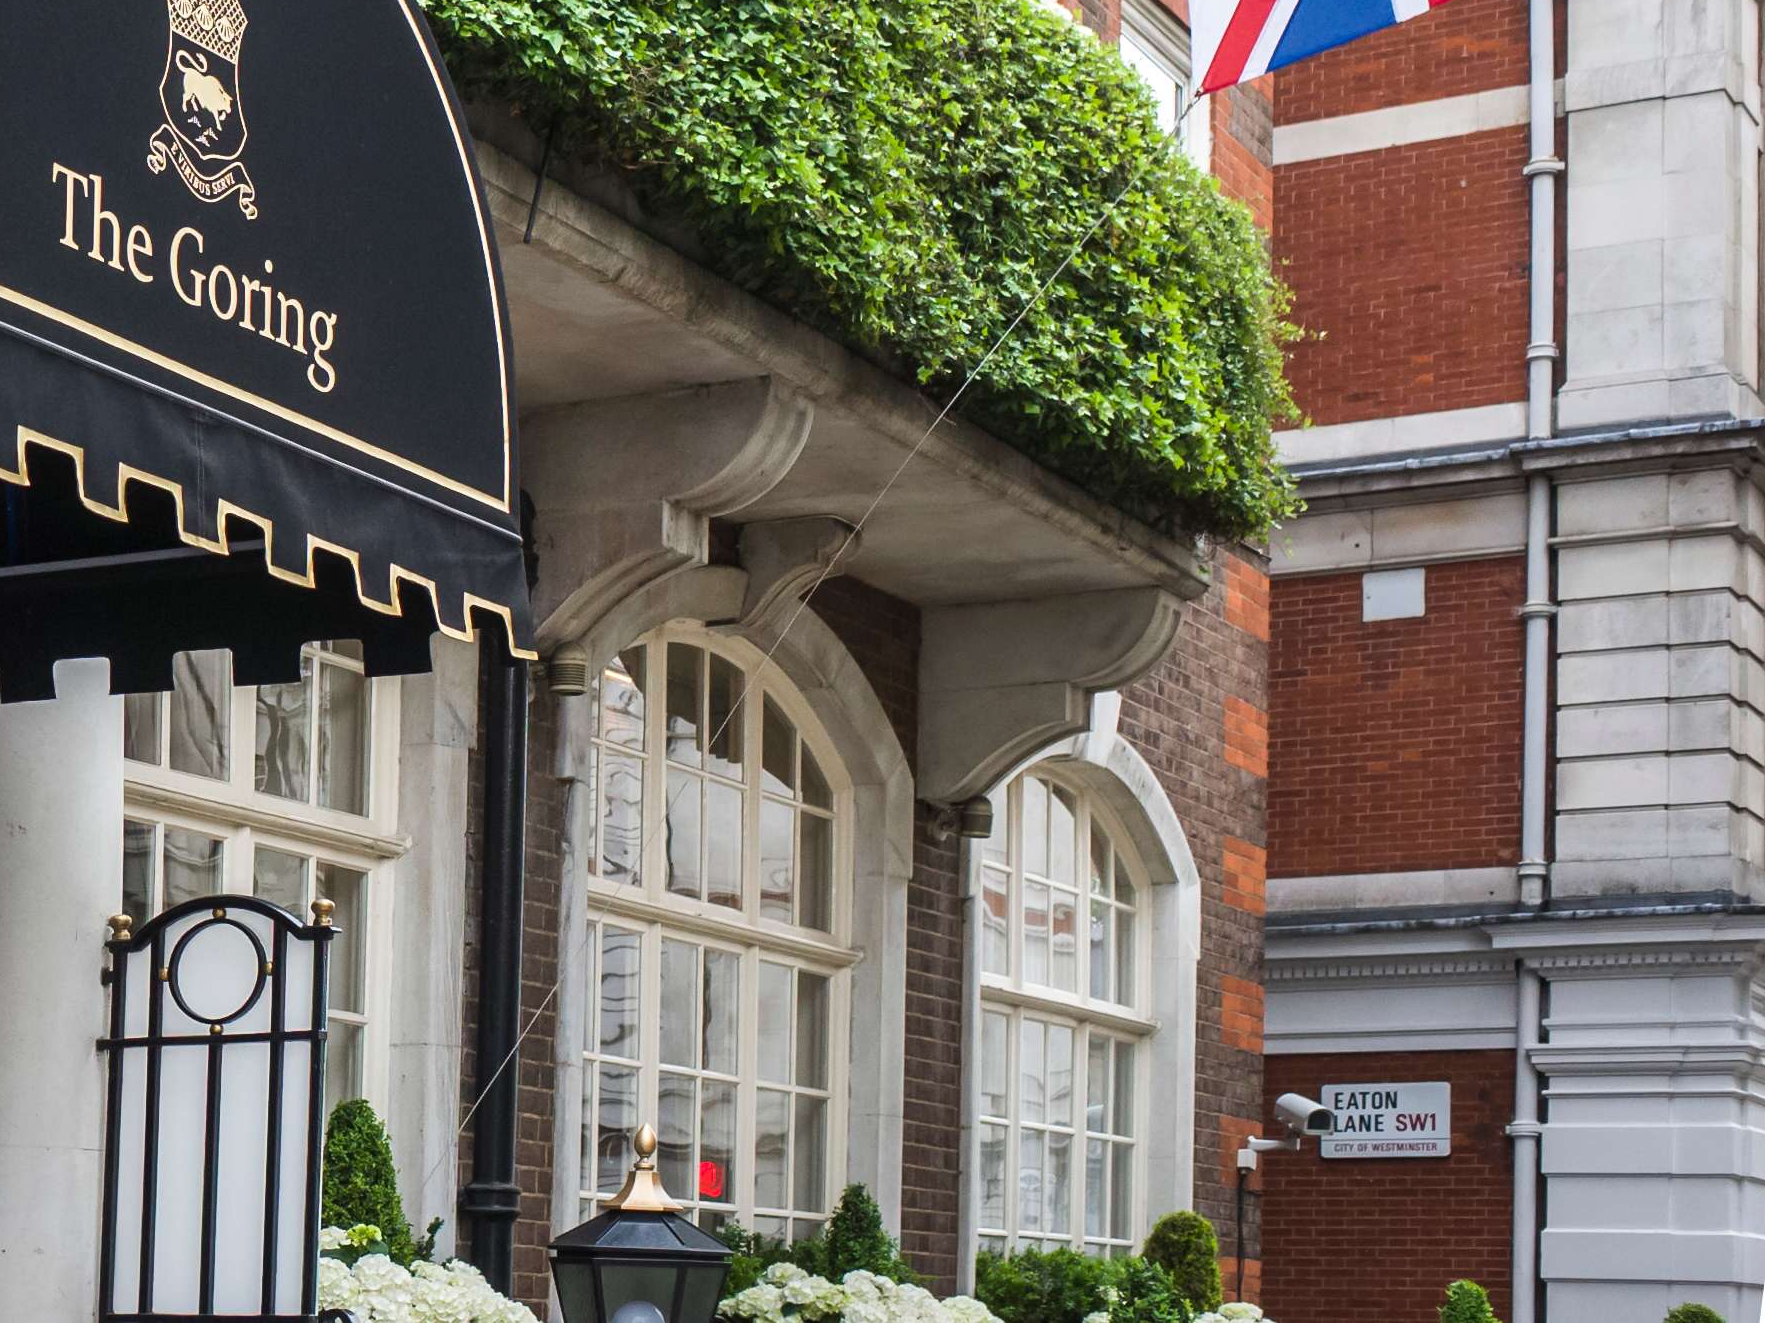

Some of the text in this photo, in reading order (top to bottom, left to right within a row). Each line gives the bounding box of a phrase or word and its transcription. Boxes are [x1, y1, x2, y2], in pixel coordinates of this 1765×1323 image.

[52, 162, 338, 393] The Goring
[1334, 1091, 1398, 1110] EATON
[1334, 1113, 1436, 1133] LANE SW1
[1334, 1142, 1437, 1152] CITY OF WESTMINSTER
